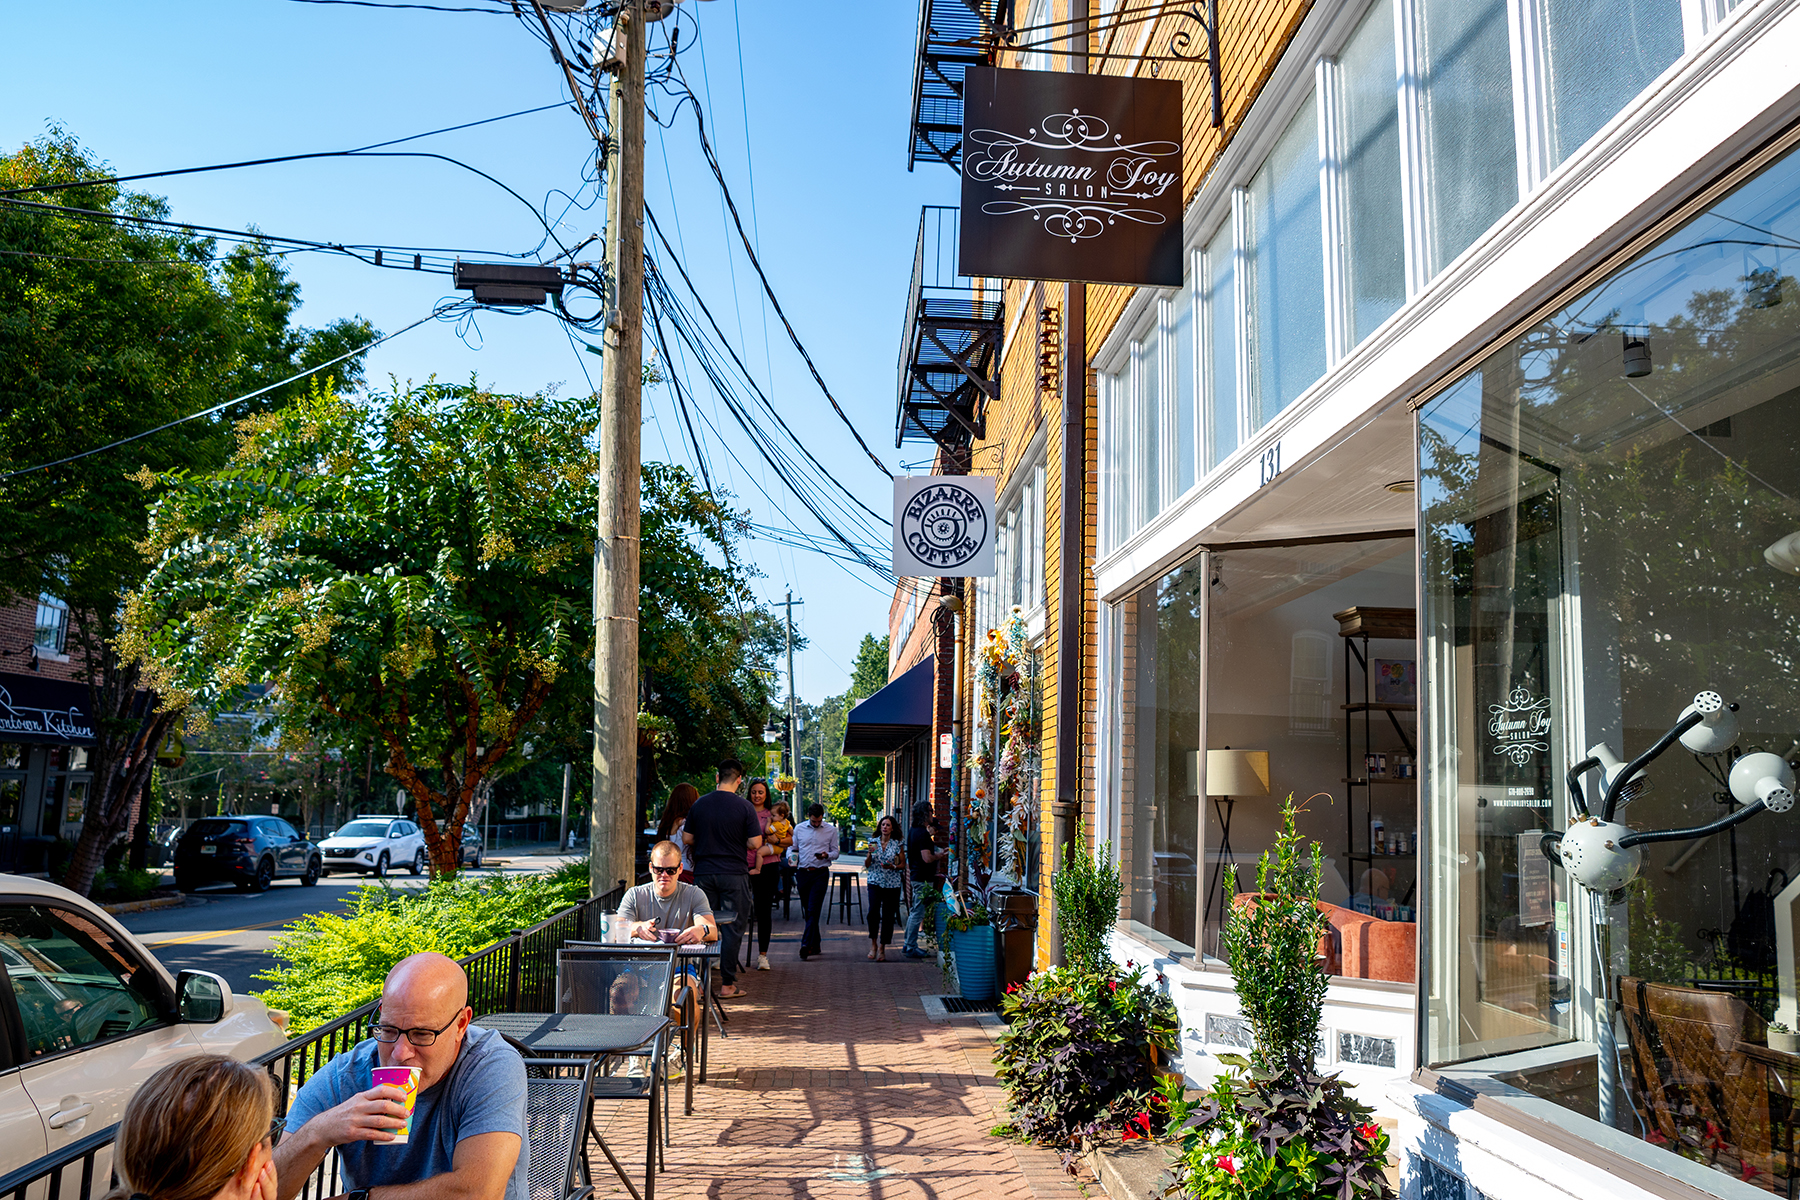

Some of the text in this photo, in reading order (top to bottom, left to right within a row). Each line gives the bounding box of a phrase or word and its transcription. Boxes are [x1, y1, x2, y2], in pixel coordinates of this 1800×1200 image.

[965, 140, 1179, 196] Autumn Joy
[1045, 183, 1108, 199] SALON
[1260, 441, 1281, 488] 131
[907, 487, 981, 522] BIZARRE
[908, 531, 978, 564] COFFEE
[42, 706, 95, 740] Kitchen
[1488, 709, 1551, 736] Autumn Joy
[1510, 731, 1530, 740] SALON
